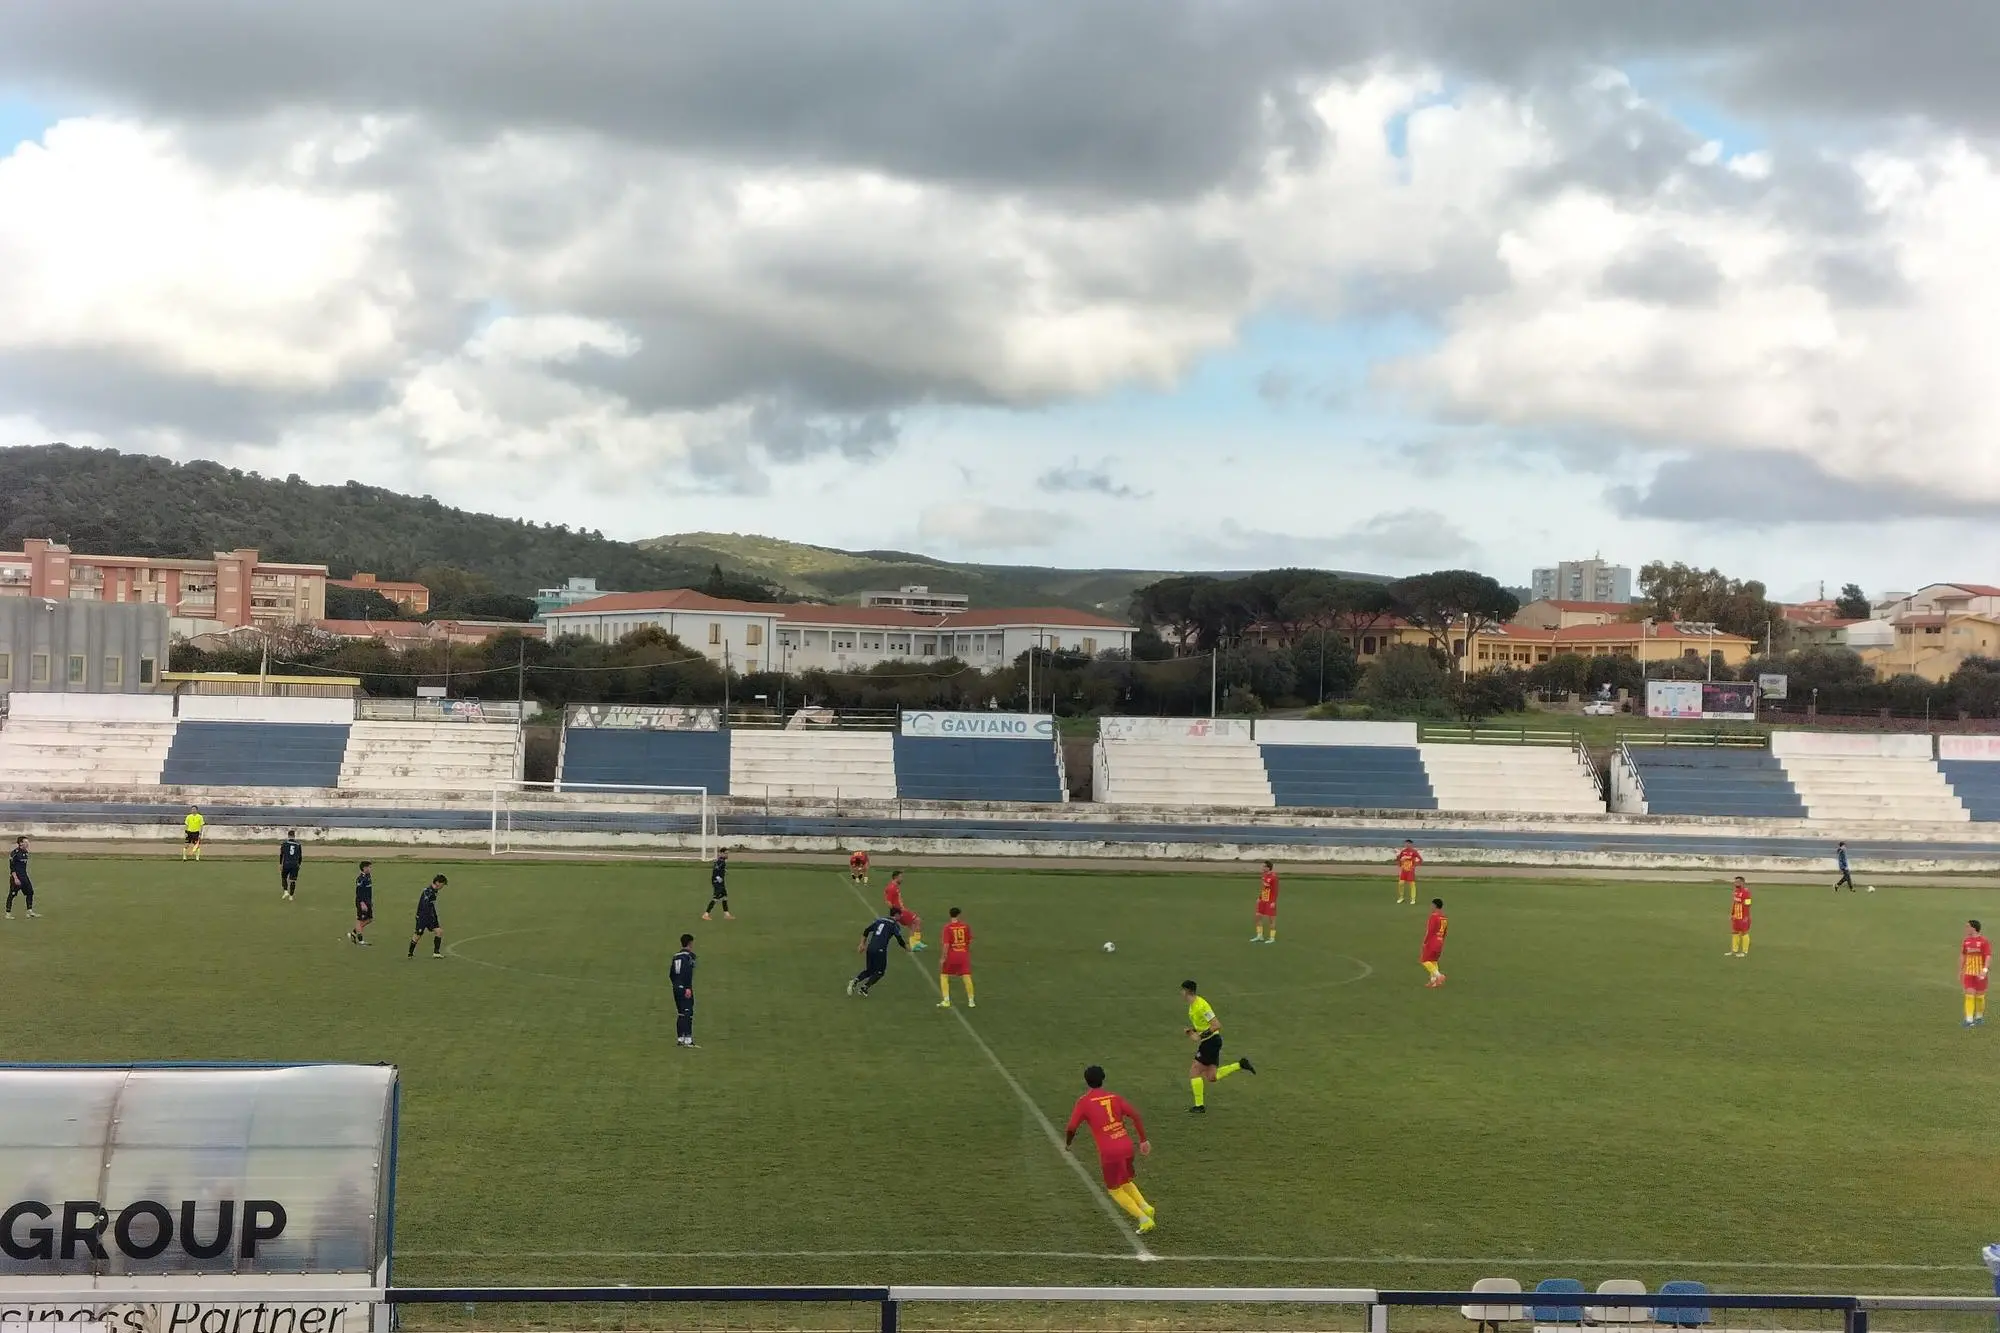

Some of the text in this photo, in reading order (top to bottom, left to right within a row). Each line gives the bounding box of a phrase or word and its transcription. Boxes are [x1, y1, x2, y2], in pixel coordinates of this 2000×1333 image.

[941, 719, 1028, 734] GAVIANO
[289, 845, 296, 856] 5
[876, 923, 885, 936] 9
[952, 928, 966, 943] 19
[1099, 1098, 1116, 1123] 7
[0, 1200, 287, 1260] GROUP
[168, 1302, 348, 1333] Partner
